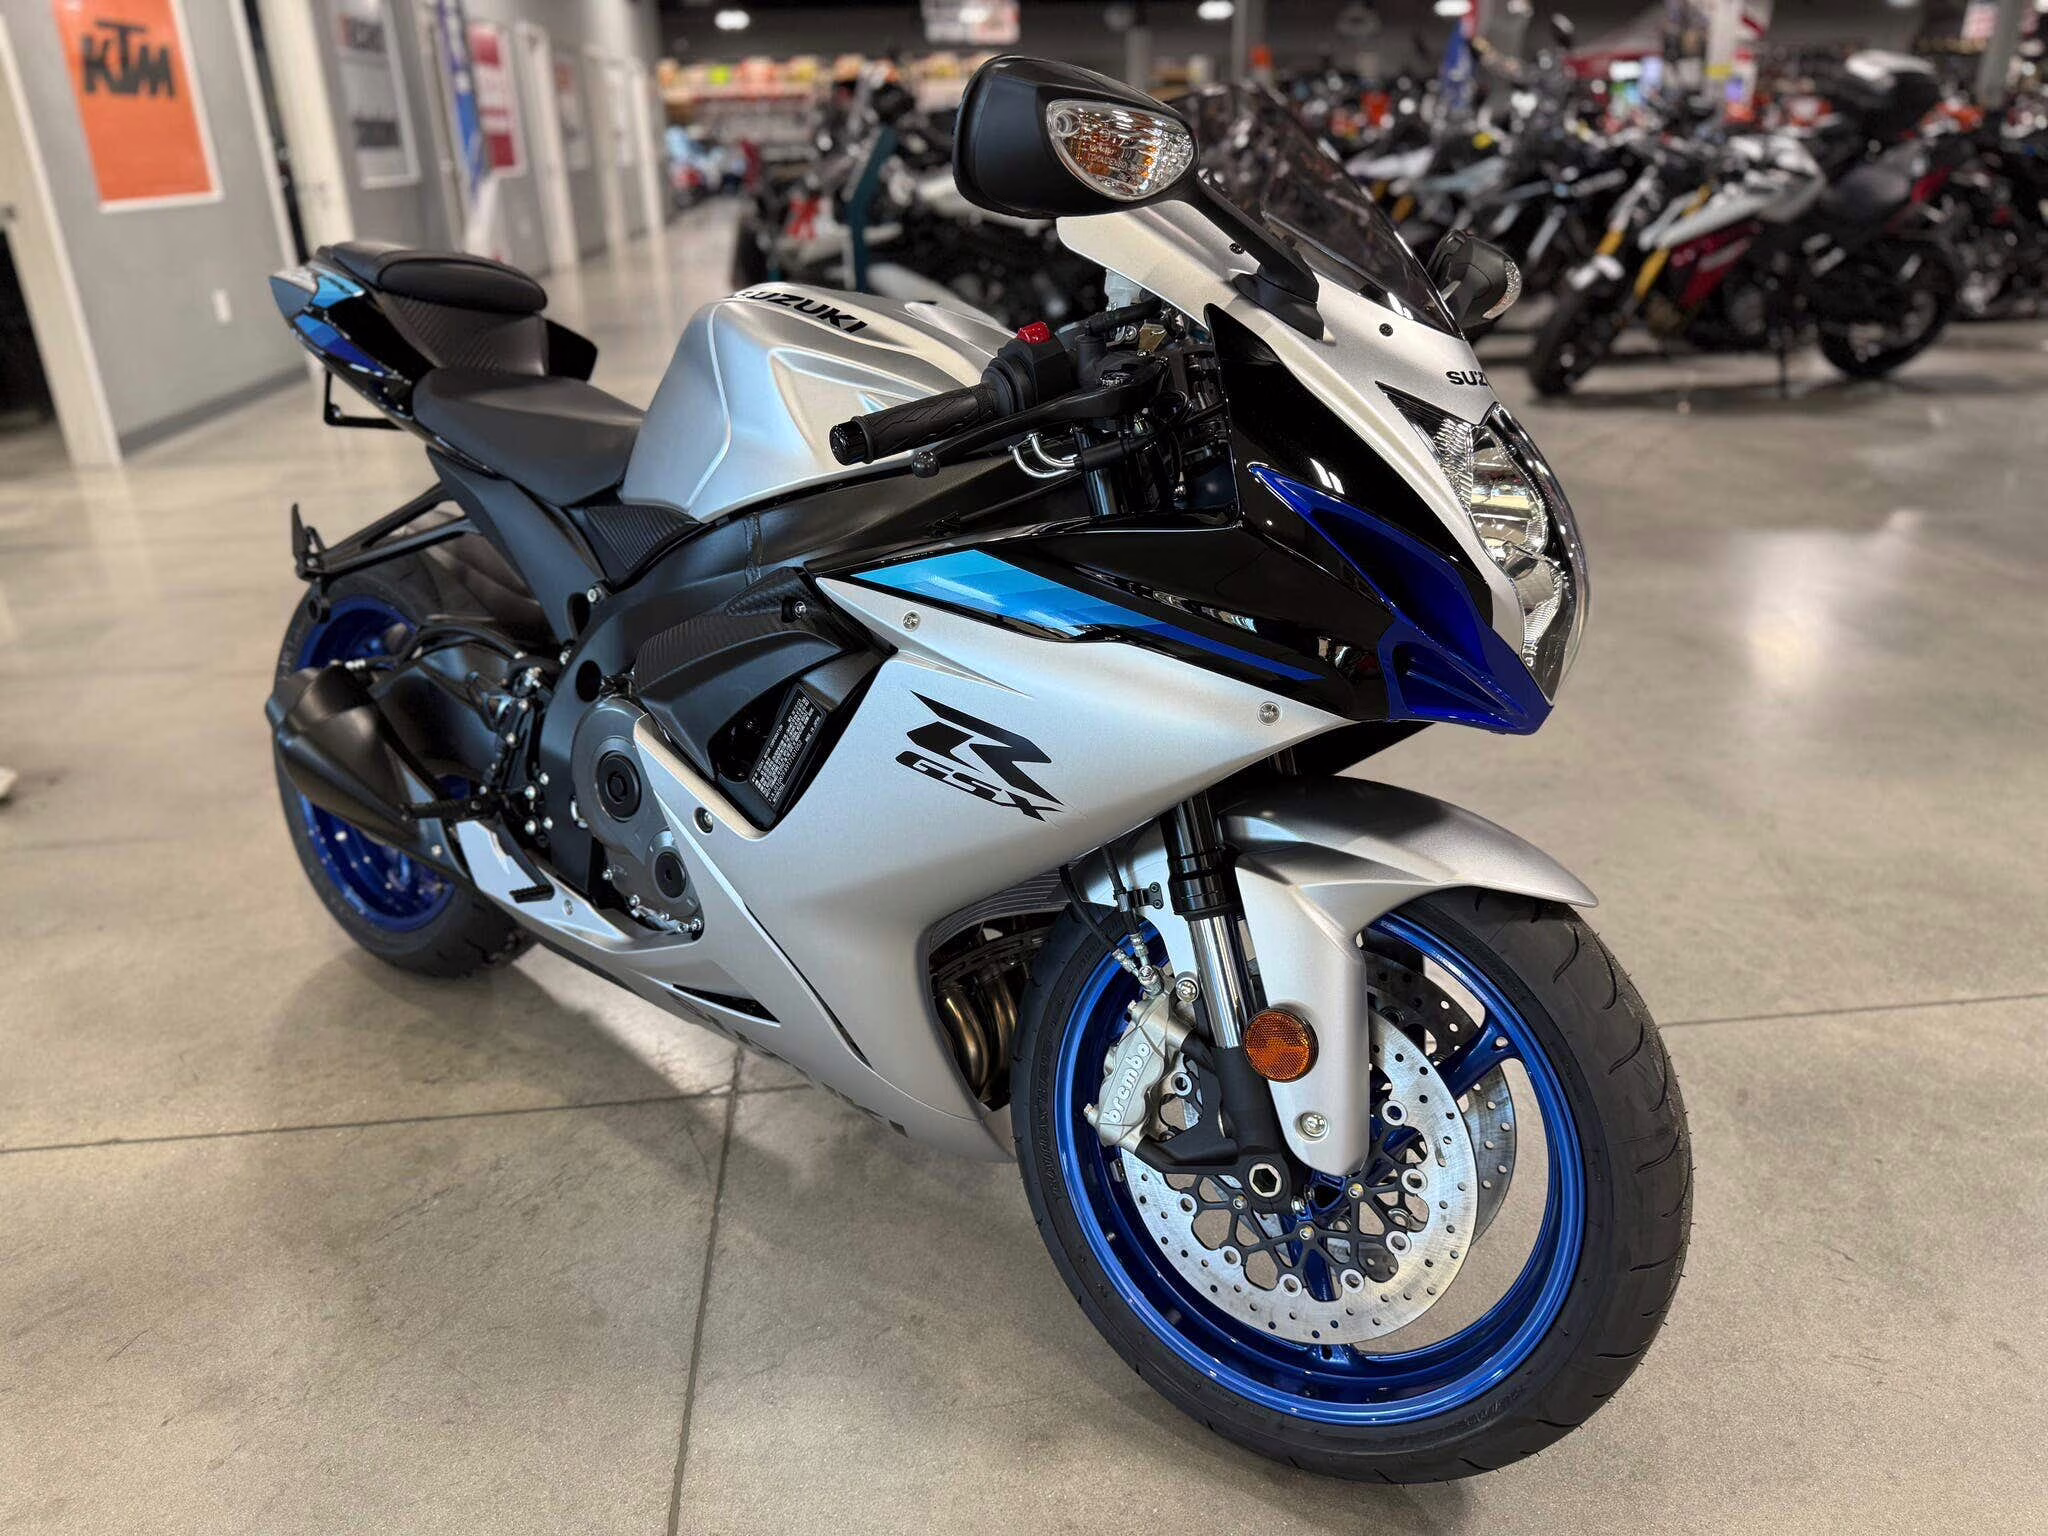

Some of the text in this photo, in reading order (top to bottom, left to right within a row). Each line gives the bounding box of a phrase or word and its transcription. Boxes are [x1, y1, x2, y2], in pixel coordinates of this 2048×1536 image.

[83, 20, 175, 98] KTM
[895, 750, 1064, 822] GSX
[906, 689, 1064, 806] R
[1103, 1042, 1151, 1123] brembo
